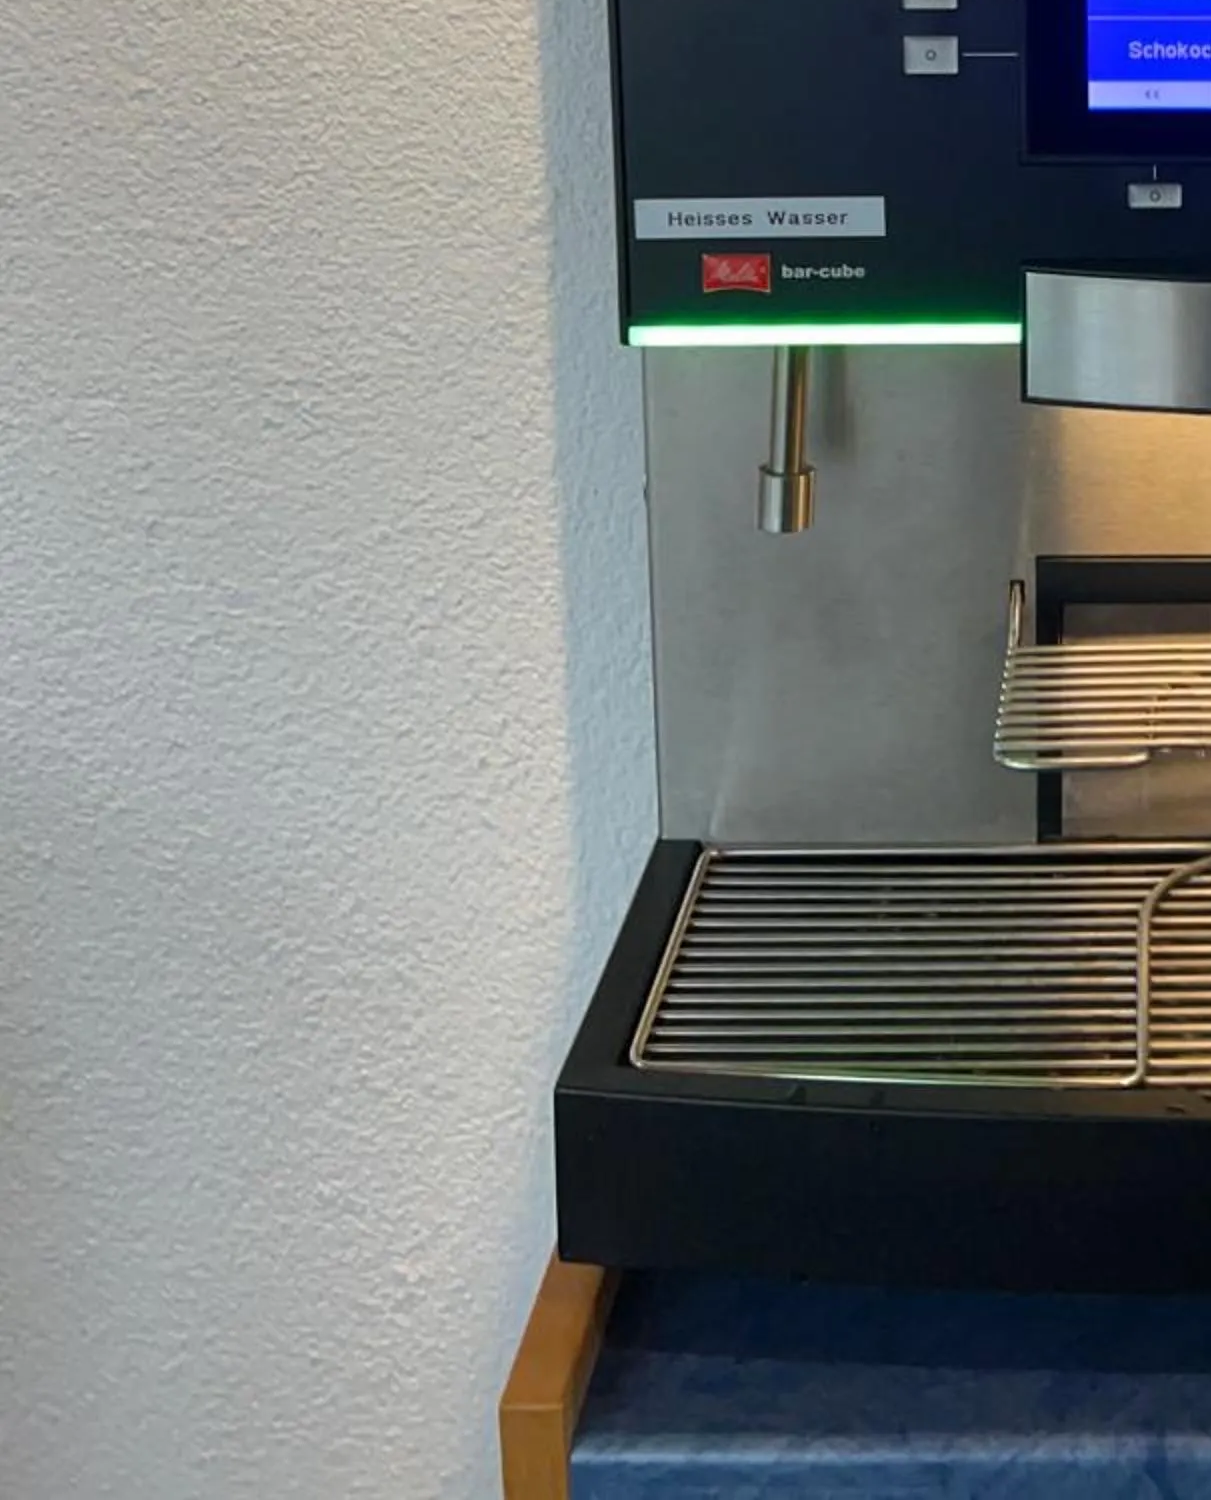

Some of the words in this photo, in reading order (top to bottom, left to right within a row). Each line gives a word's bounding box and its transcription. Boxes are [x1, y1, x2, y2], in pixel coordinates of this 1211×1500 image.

[667, 211, 753, 227] Heisses
[767, 209, 849, 226] Wasser
[781, 264, 865, 279] bar-cube
